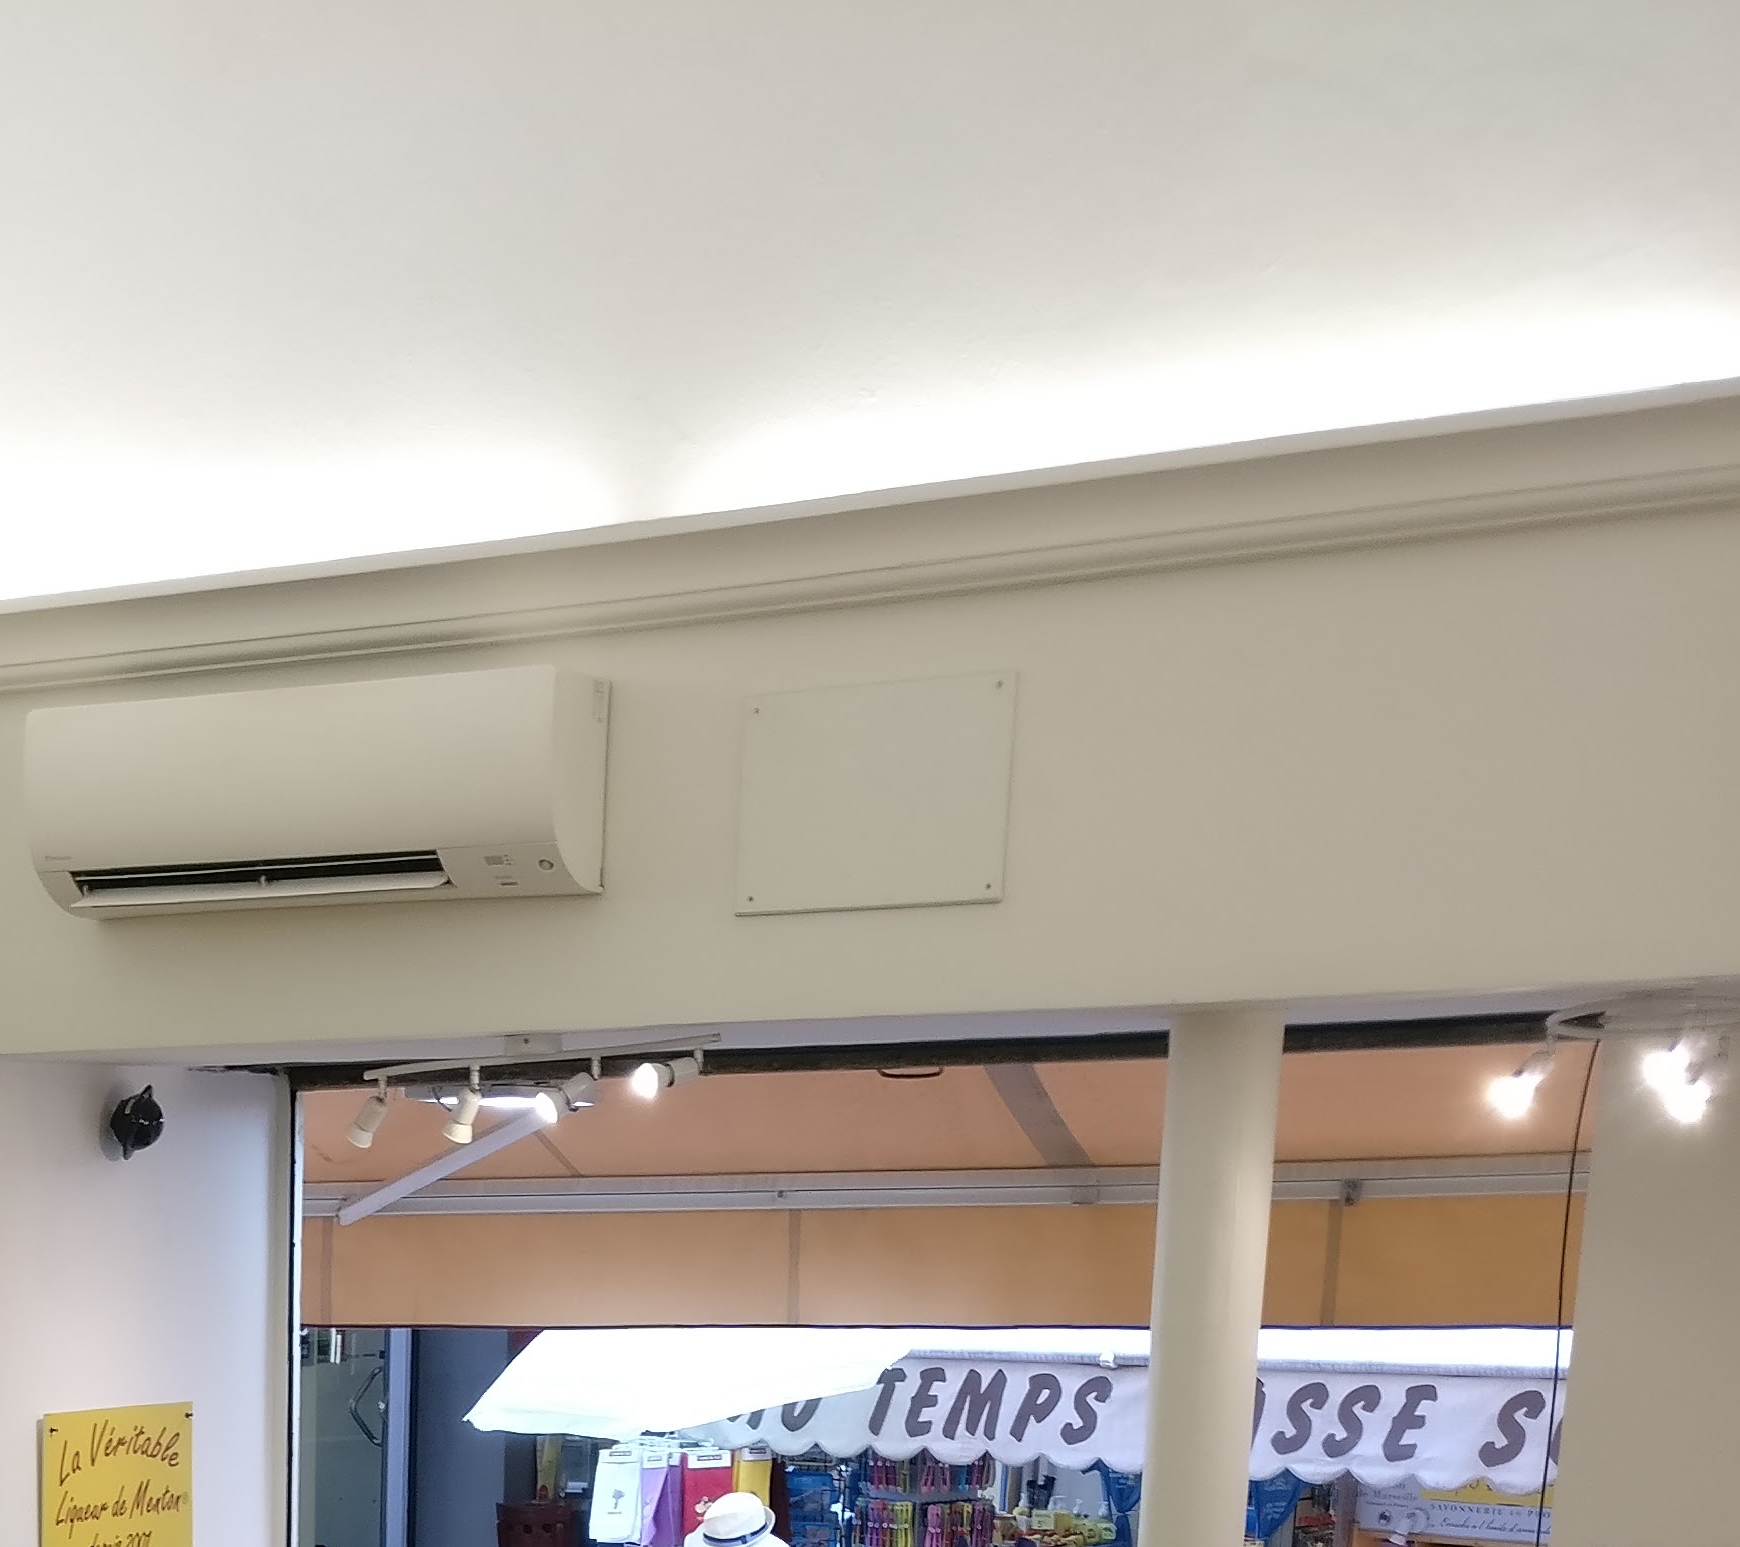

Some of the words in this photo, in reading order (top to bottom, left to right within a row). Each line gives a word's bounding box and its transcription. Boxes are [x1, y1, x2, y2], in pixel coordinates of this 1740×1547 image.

[867, 1366, 1114, 1446] TEMPS
[59, 1440, 82, 1487] La
[90, 1419, 181, 1468] Véritable
[56, 1486, 109, 1539] Liqueur
[115, 1486, 128, 1516] de
